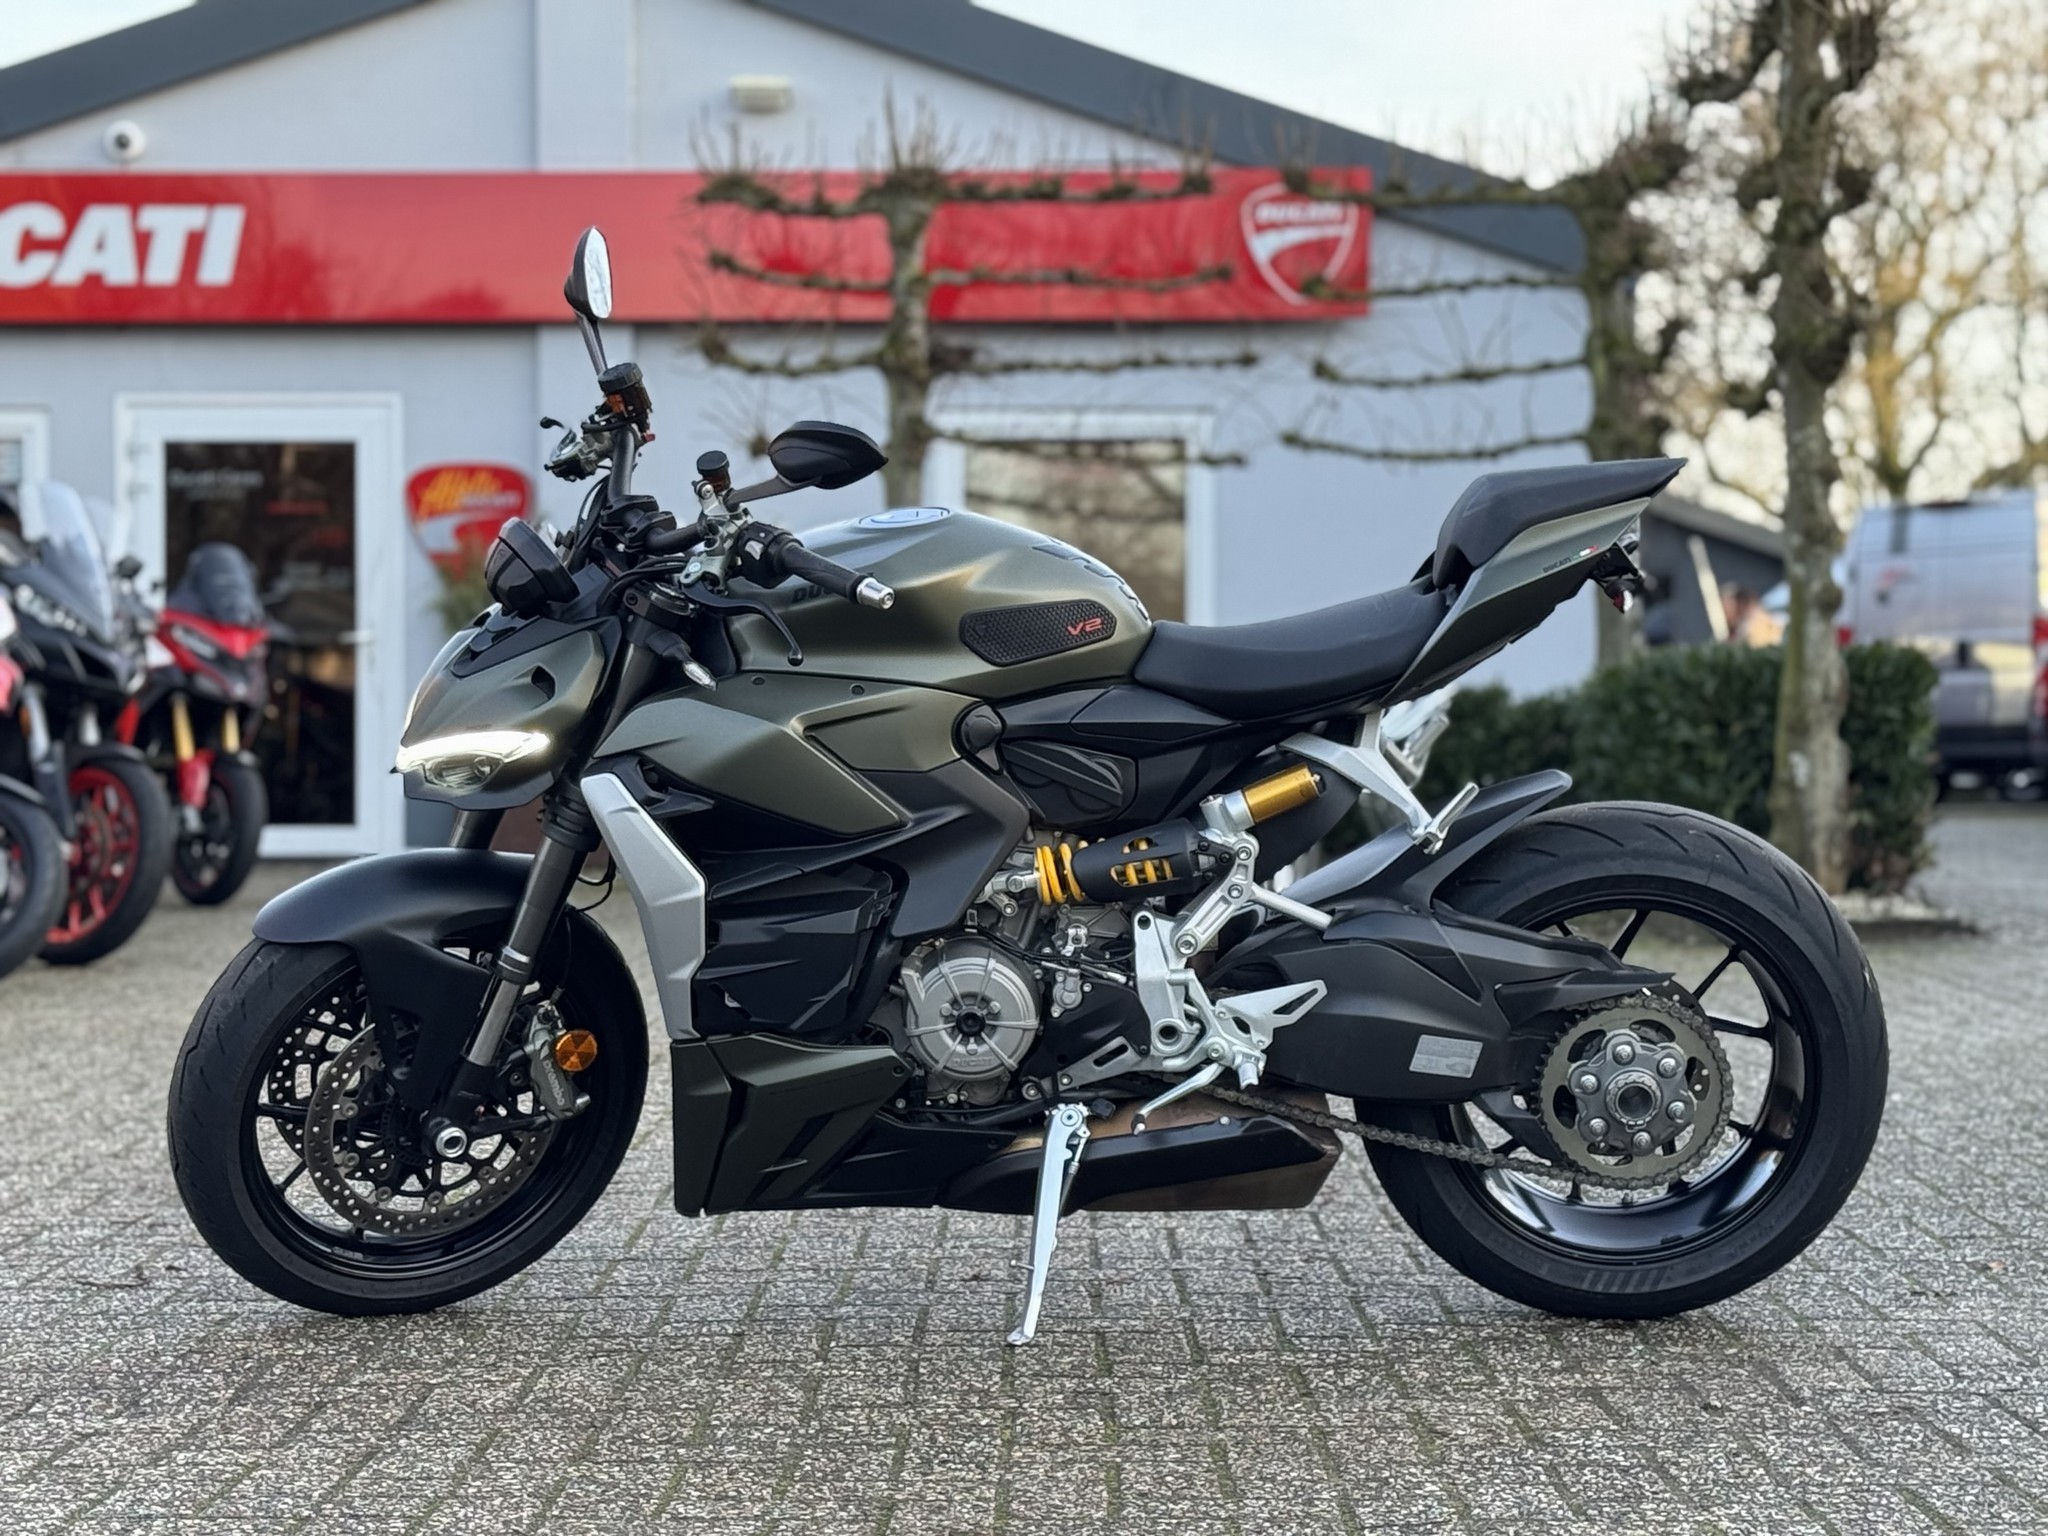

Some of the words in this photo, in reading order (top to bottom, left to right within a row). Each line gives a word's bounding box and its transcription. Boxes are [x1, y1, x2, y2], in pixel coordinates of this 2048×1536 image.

[0, 201, 246, 289] CATI
[1543, 557, 1572, 573] DUCATI
[792, 584, 824, 604] DU
[1067, 617, 1102, 635] V2
[542, 1058, 565, 1106] brembo
